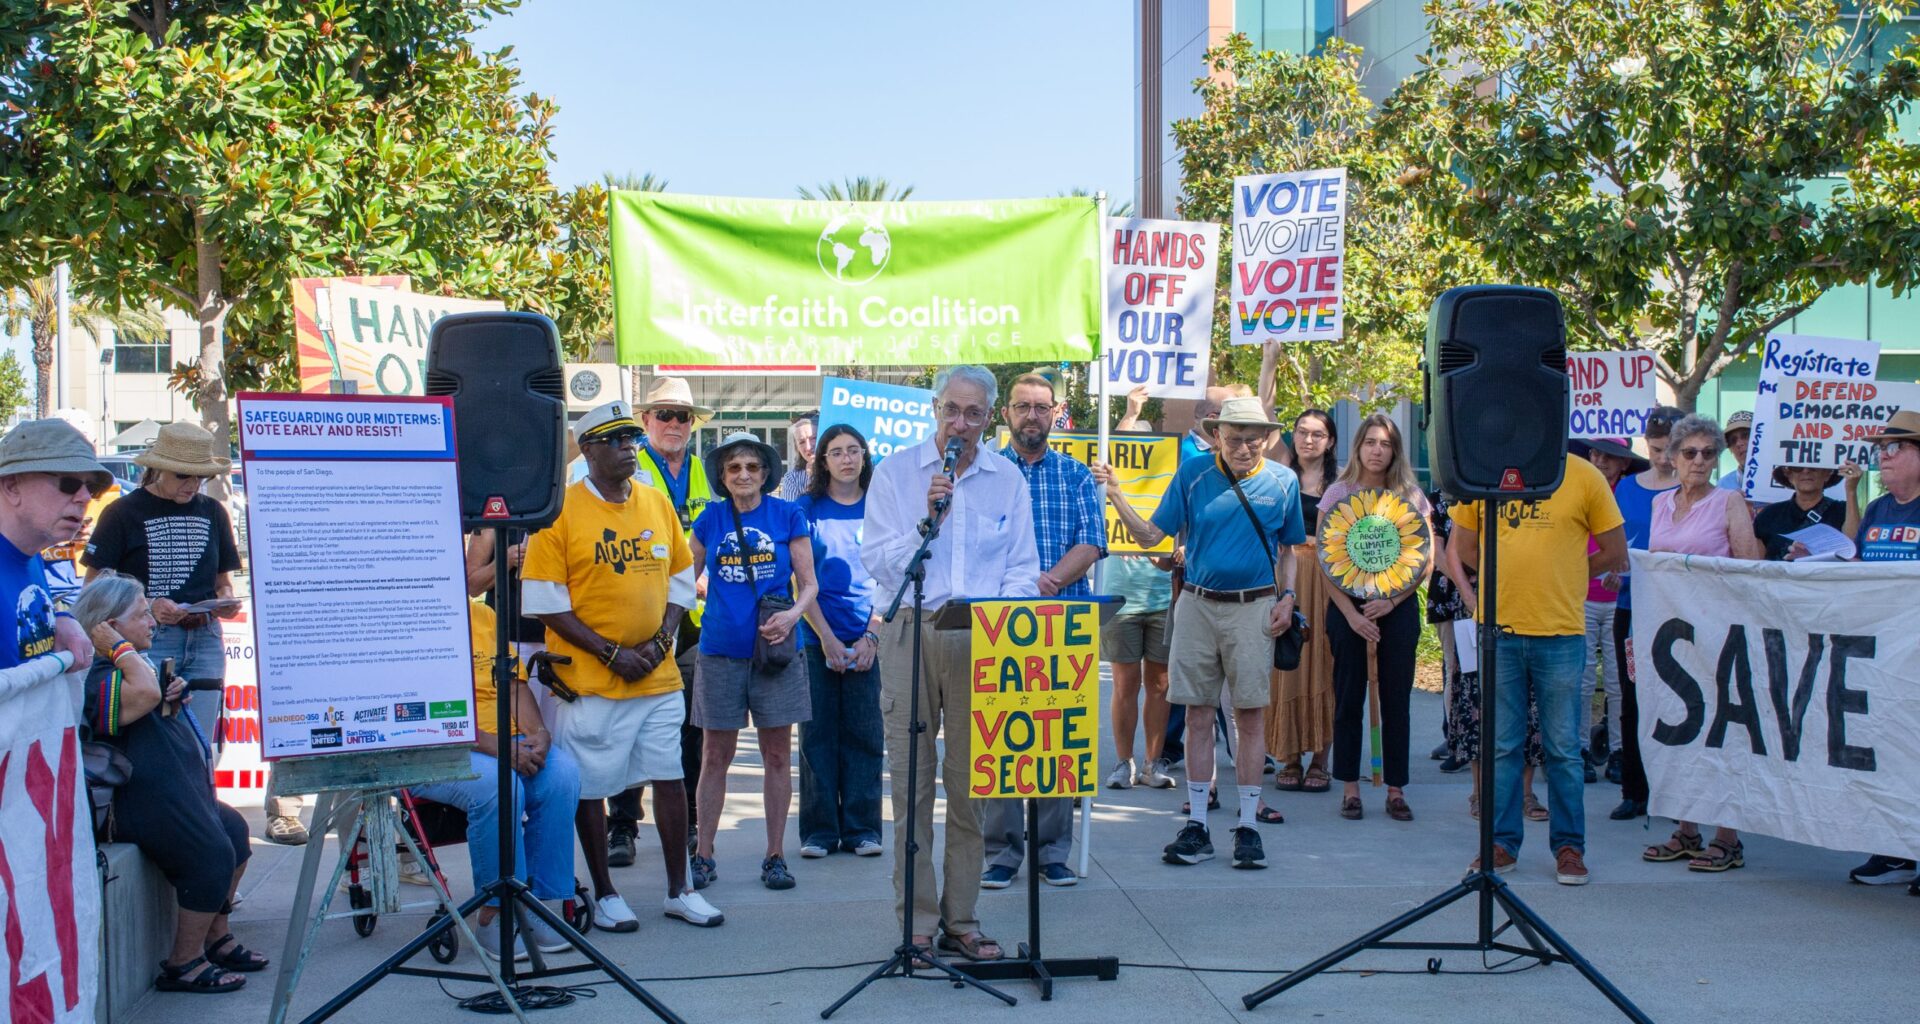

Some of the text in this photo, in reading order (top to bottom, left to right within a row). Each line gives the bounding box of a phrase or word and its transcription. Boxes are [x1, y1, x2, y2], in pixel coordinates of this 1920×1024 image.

[1242, 178, 1340, 218] VOTE
[1240, 216, 1340, 256] VOTE
[1113, 229, 1206, 270] HANDS
[1238, 256, 1339, 296] VOTE
[1124, 272, 1186, 306] OFF
[682, 294, 1020, 328] Interfaith Coalition
[1237, 297, 1338, 336] VOTE
[350, 297, 449, 348] HAN
[1118, 310, 1184, 346] OUR
[1108, 348, 1197, 386] VOTE
[1764, 339, 1871, 376] Regístrate
[1566, 356, 1654, 390] AND UP
[1574, 392, 1602, 406] FOR
[1796, 381, 1877, 401] DEFEND
[245, 410, 441, 425] SAFEGUARDING OUR MIDTERMS:
[1570, 408, 1652, 435] OCRACY
[1780, 402, 1900, 422] DEMOCRACY
[246, 424, 402, 437] VOTE EARLY AND RESIST!
[874, 416, 930, 440] NOT
[1792, 422, 1833, 440] AND
[1050, 442, 1073, 456] TE
[1780, 440, 1875, 464] THE PLA
[144, 517, 168, 526] TRICKLE
[145, 524, 169, 532] TRICKLE
[1368, 525, 1388, 533] CARE
[146, 529, 170, 538] TRICKLE
[1354, 539, 1394, 550] CLIMATE
[1869, 528, 1917, 541] CBFD
[595, 538, 644, 565] ACCE
[720, 553, 772, 565] SAN IEGO
[1362, 555, 1391, 565] VOTE
[972, 604, 1092, 647] VOTE
[226, 646, 254, 659] AR O
[974, 653, 1094, 693] EARLY
[225, 685, 258, 711] OR
[1652, 617, 1876, 772] SAVE
[283, 714, 305, 722] DIEGO
[354, 706, 388, 722] ACTIVATE!
[359, 730, 378, 738] Diego
[442, 721, 469, 730] THIRD ACT
[972, 707, 1090, 752] VOTE
[312, 737, 336, 745] UNITED
[346, 736, 376, 744] UNITED
[972, 752, 1094, 796] SECURE
